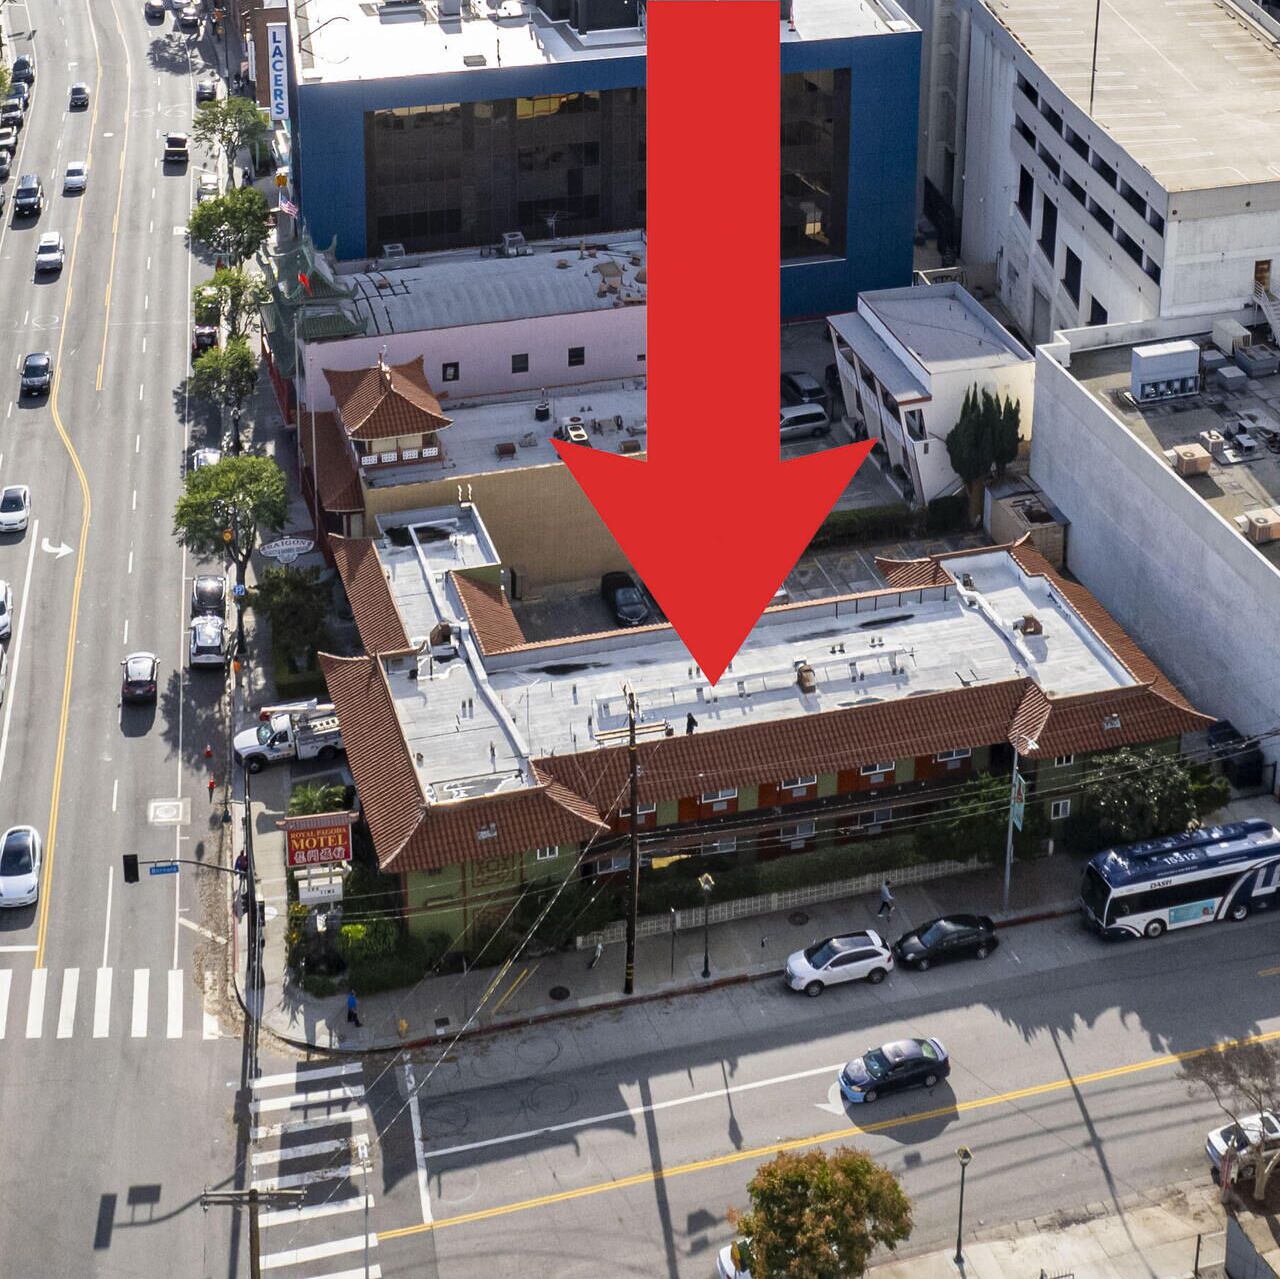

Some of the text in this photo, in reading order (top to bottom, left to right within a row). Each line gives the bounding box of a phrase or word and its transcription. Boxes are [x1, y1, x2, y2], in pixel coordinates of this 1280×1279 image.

[272, 31, 284, 115] LACERS
[291, 827, 347, 839] ROYAL PAGODA
[292, 834, 345, 849] MOTEL
[1150, 879, 1172, 890] DASH
